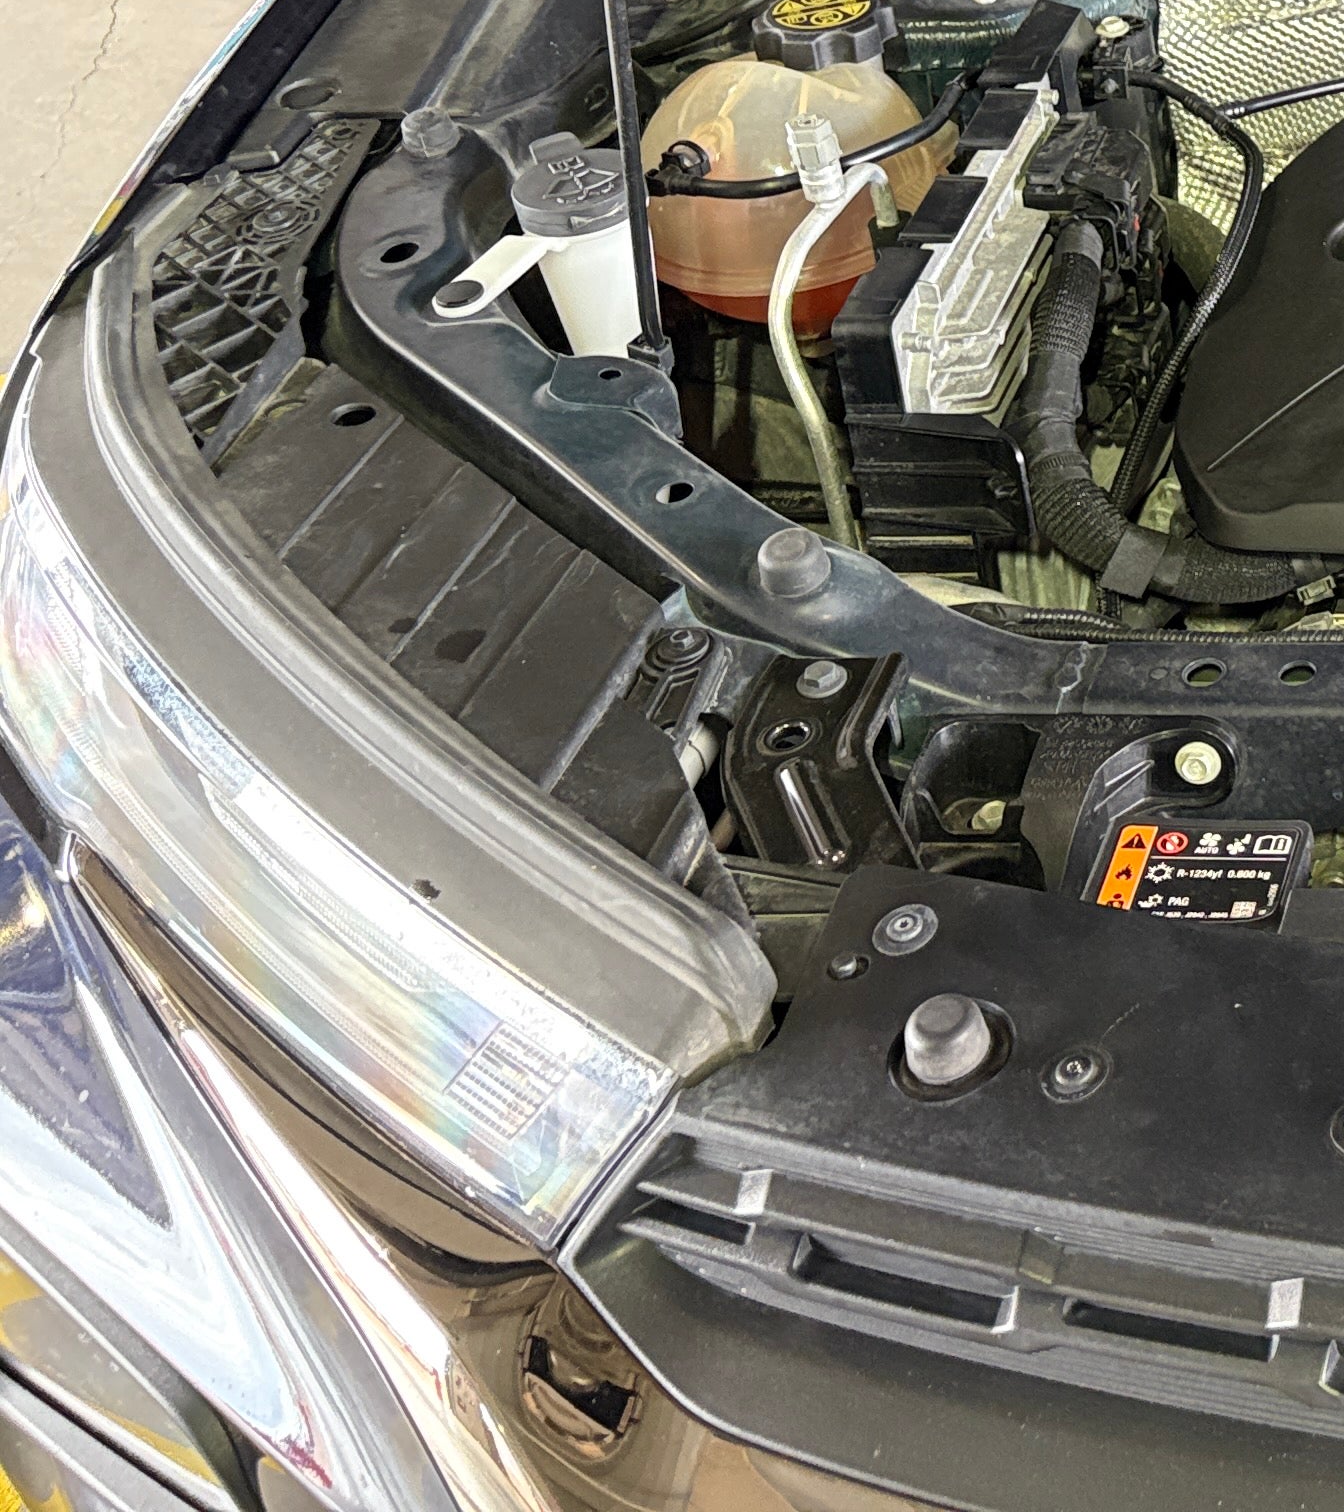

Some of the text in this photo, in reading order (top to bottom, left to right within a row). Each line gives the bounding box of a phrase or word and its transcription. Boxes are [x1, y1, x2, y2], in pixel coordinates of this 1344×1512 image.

[1194, 846, 1219, 854] AUTO
[1177, 868, 1223, 880] R-1234yf
[1257, 870, 1271, 880] kg
[1167, 896, 1190, 906] PAG
